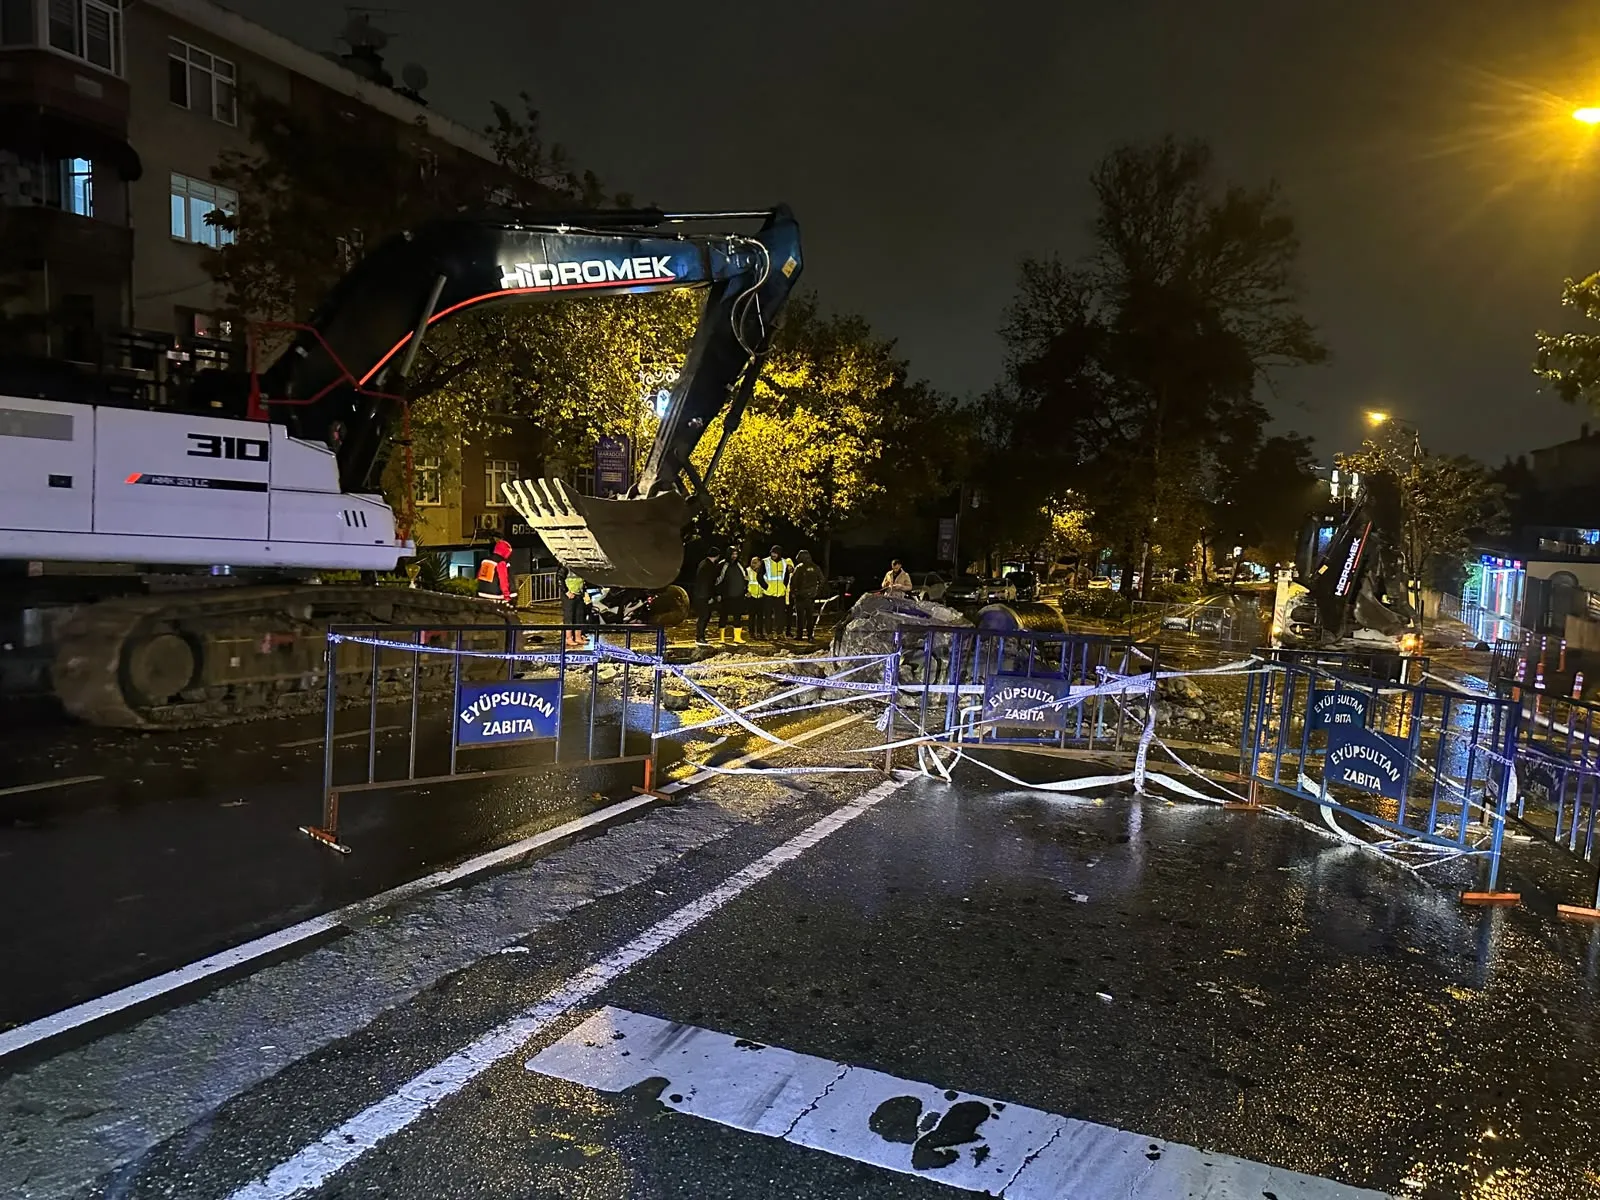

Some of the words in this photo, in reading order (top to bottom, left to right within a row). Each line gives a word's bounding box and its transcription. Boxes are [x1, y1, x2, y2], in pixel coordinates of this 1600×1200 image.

[186, 432, 269, 462] 310
[460, 691, 555, 725] EYÜPSULTAN
[989, 687, 1063, 712] EYÜPSULTAN
[482, 719, 534, 737] ZABITA
[1004, 709, 1045, 722] ZABITA
[1330, 743, 1401, 782] EYÜPSULTAN
[1343, 768, 1381, 791] ZABITA
